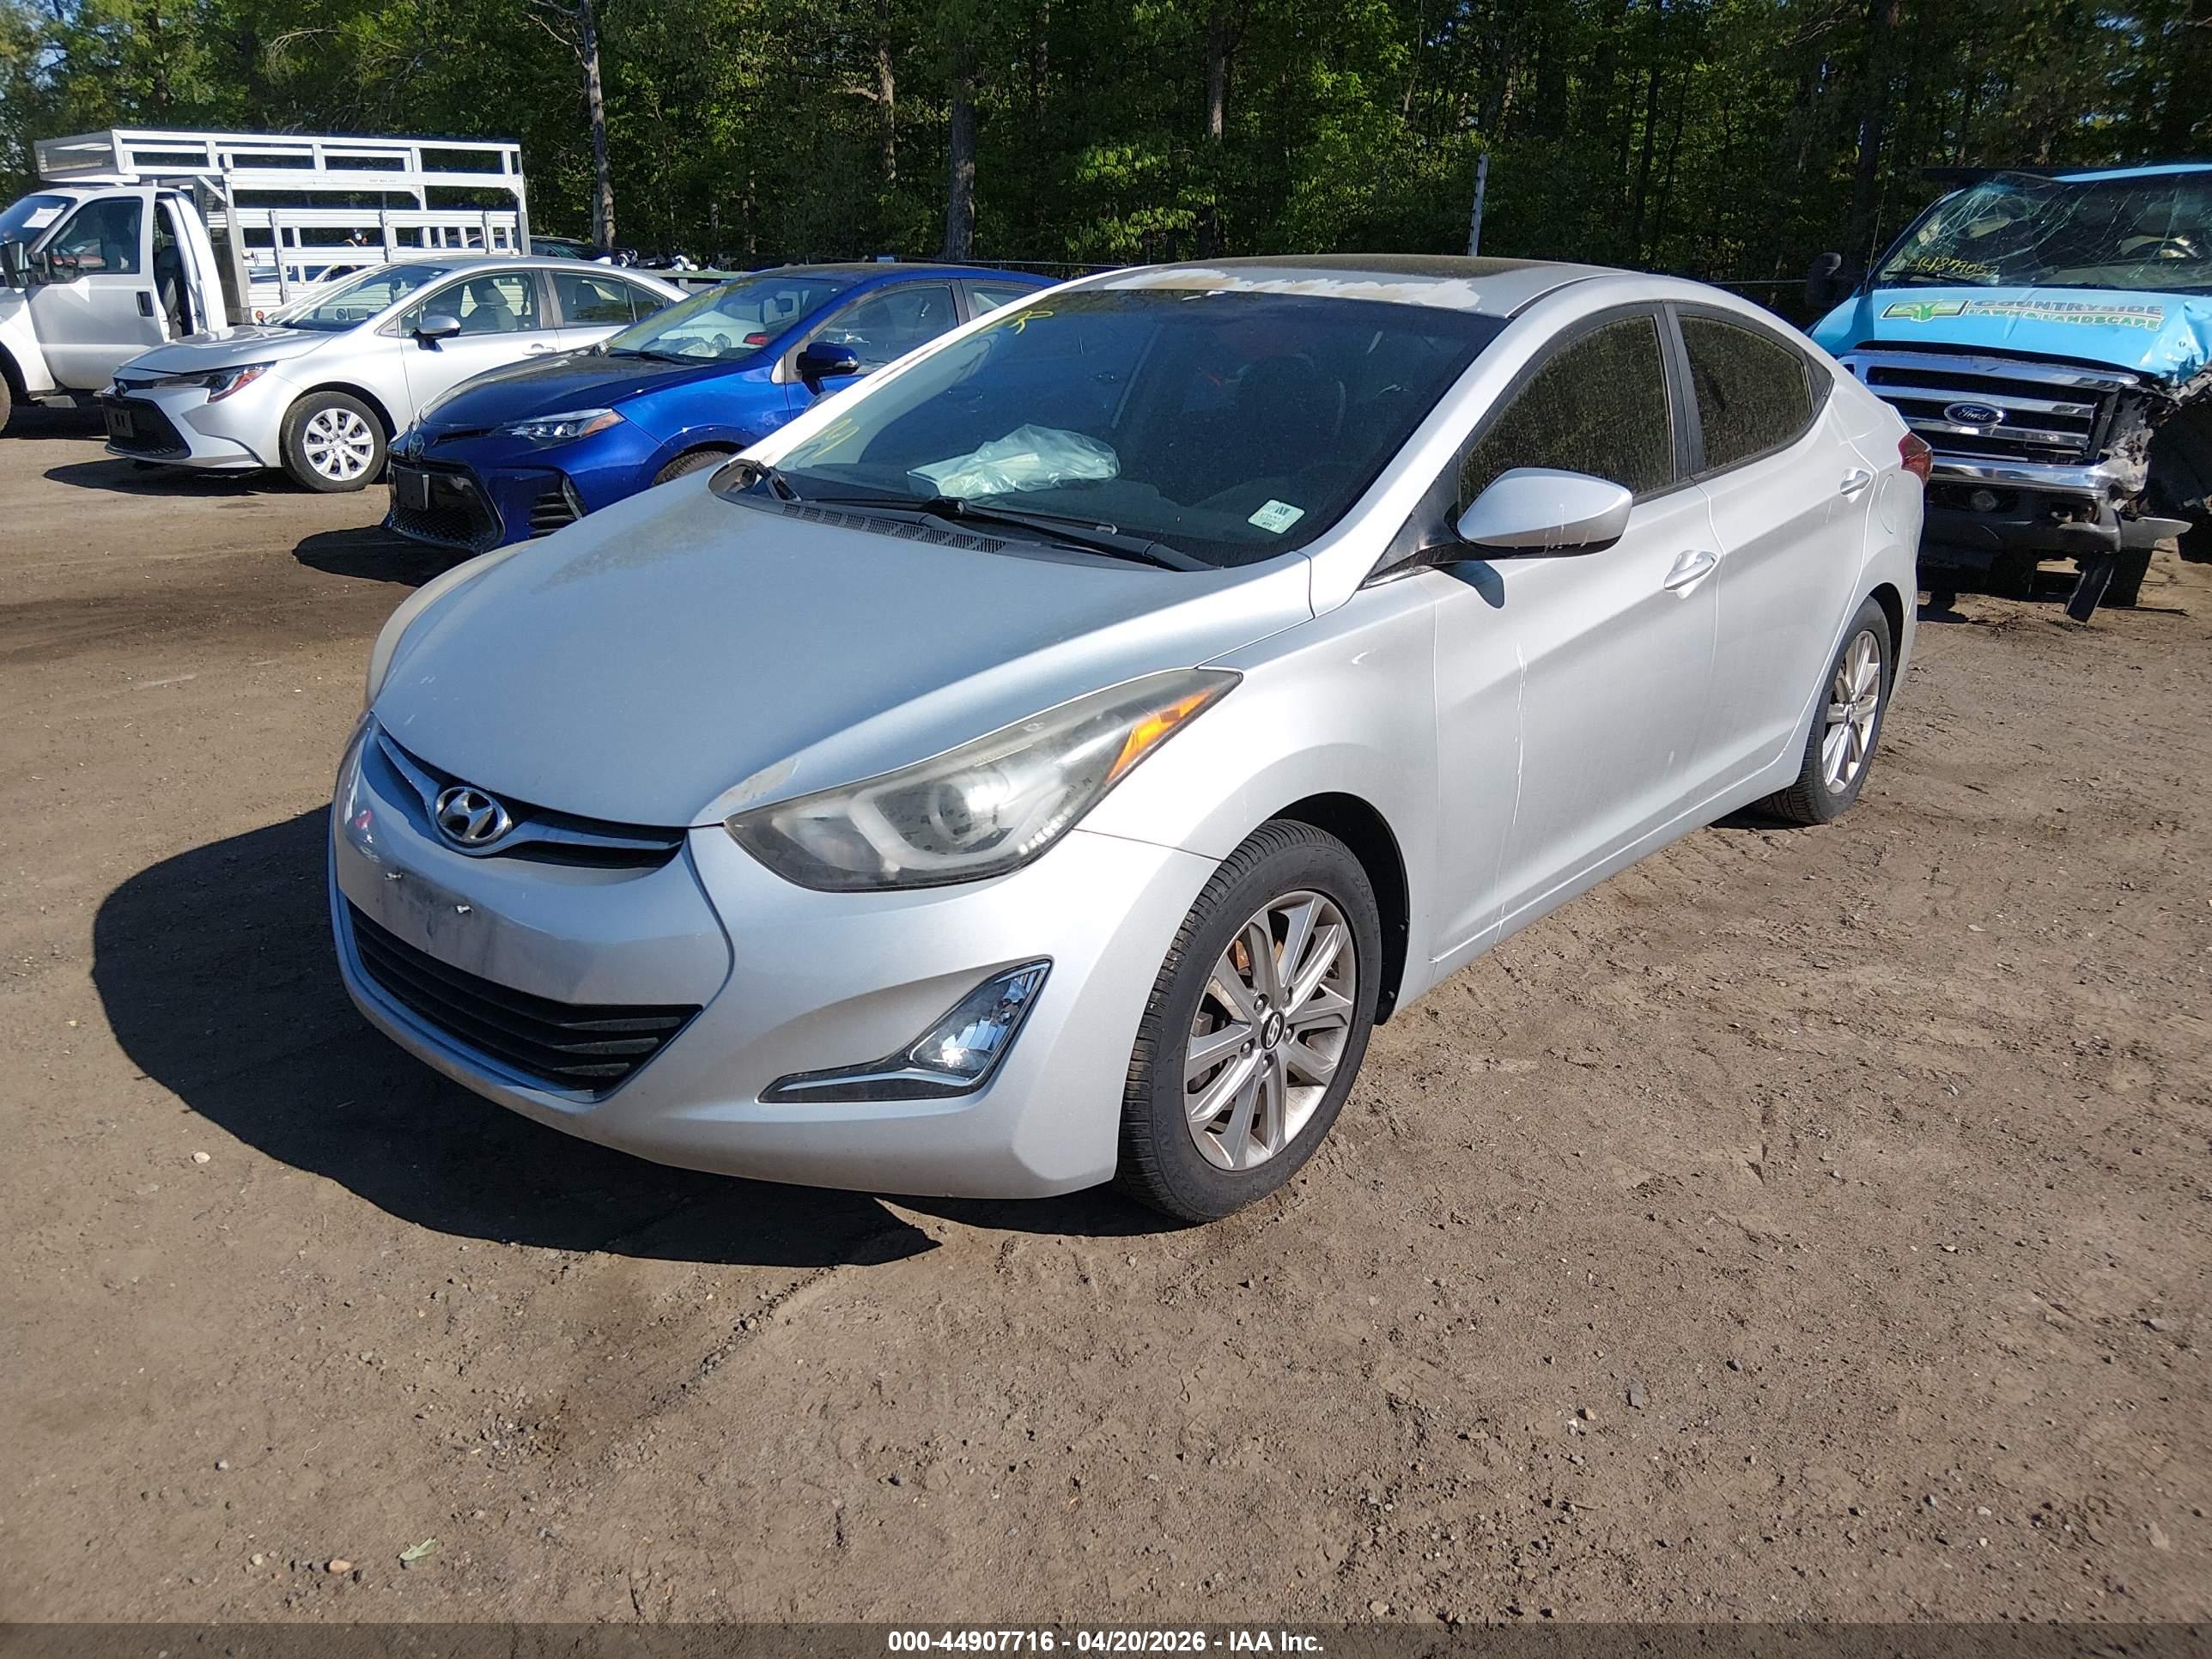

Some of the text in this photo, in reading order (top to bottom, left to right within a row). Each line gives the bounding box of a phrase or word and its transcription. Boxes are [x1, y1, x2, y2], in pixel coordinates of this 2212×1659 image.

[1974, 300, 2163, 315] COUNTRYSIDE
[2040, 313, 2160, 331] LANDSCAPE
[1958, 406, 1990, 420] Ford
